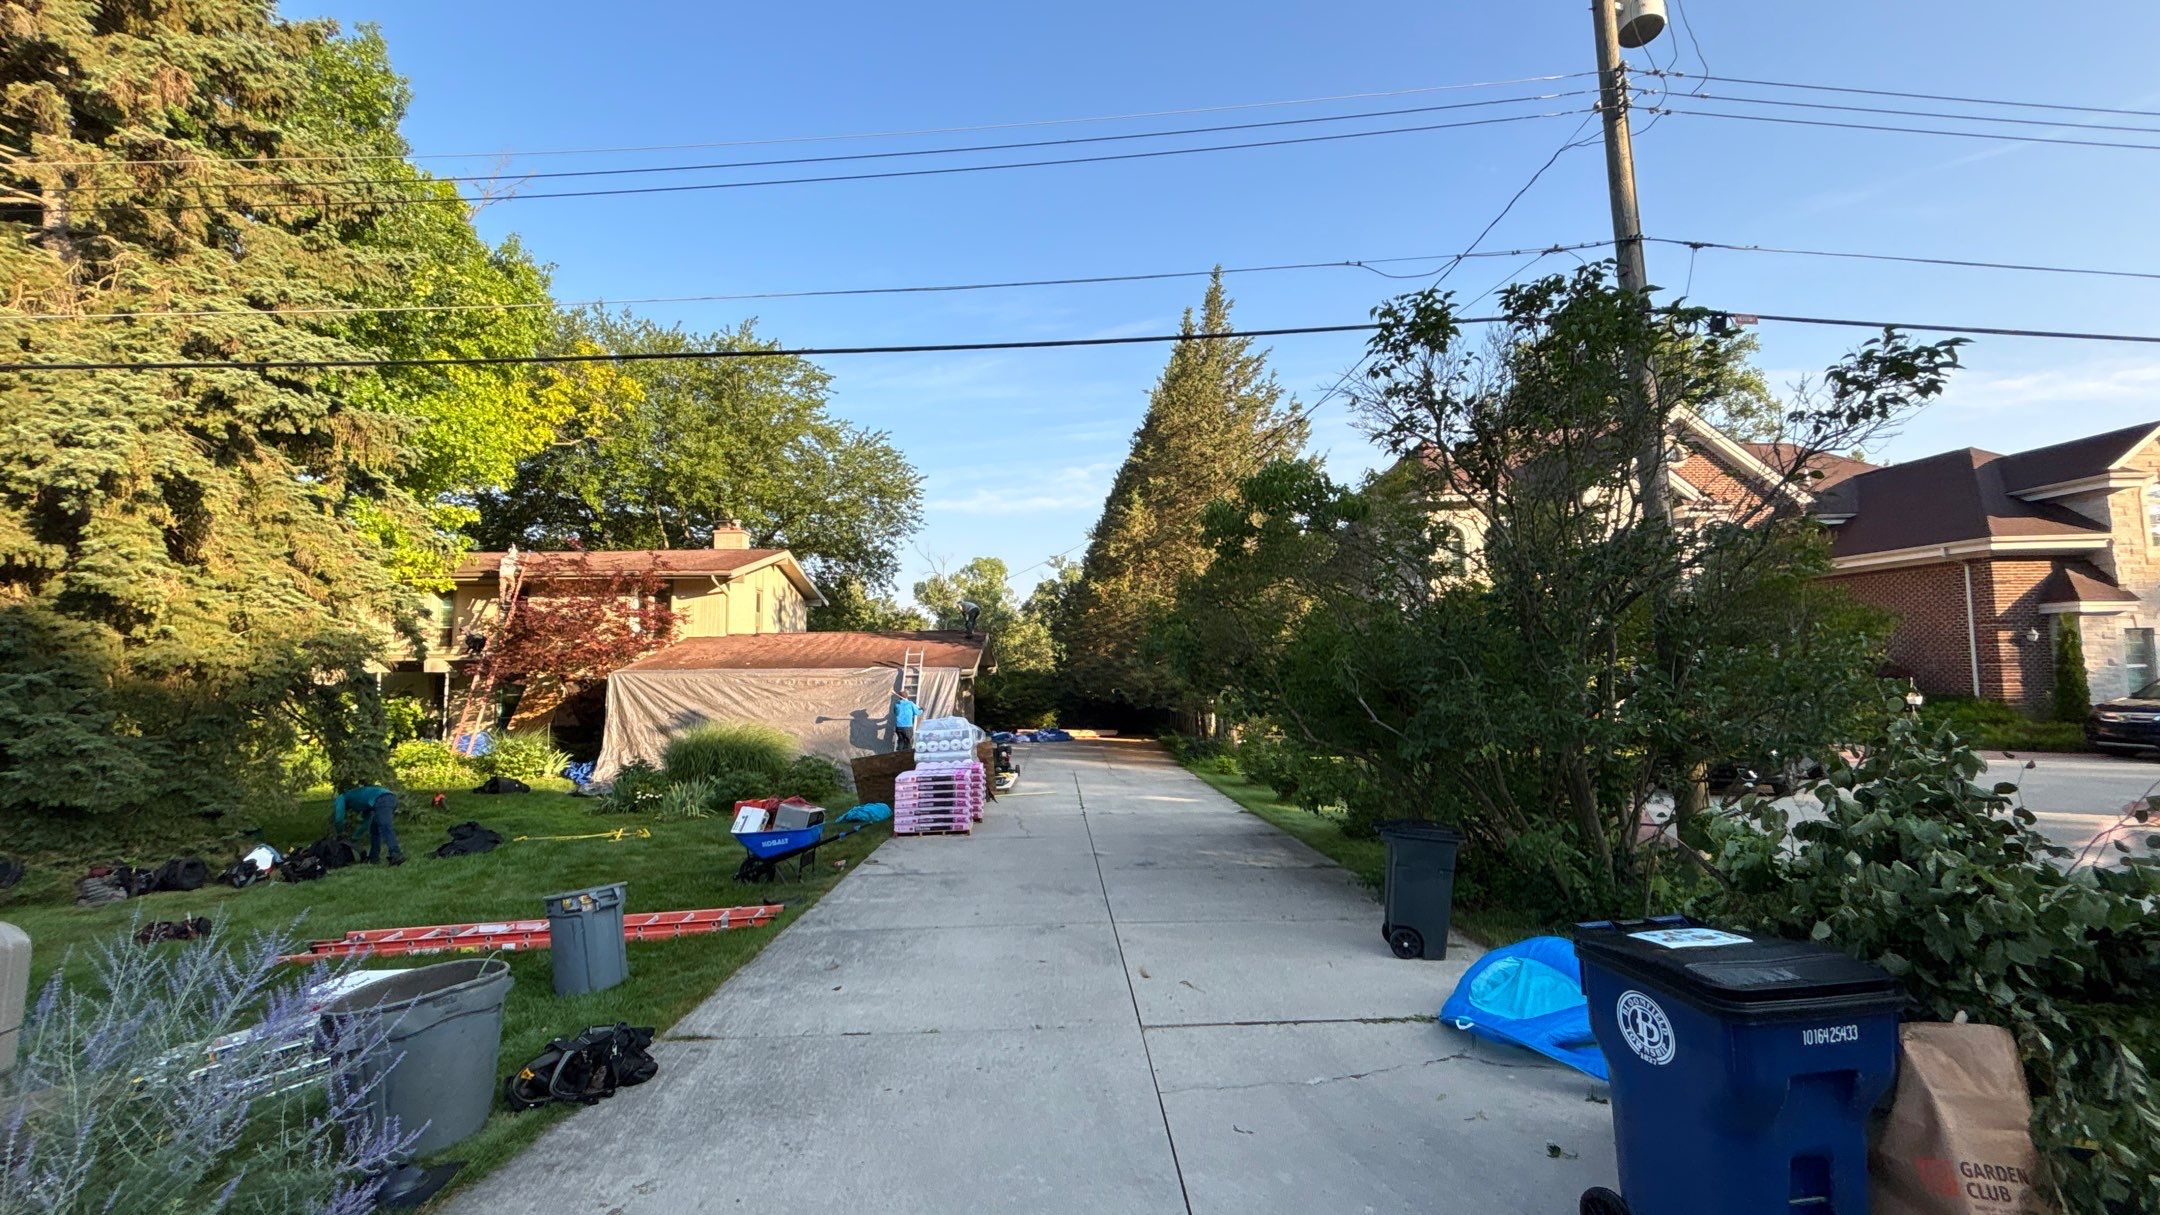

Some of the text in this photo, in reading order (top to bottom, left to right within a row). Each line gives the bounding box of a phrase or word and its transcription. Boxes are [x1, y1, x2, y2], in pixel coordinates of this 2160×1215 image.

[761, 838, 789, 848] KOBALT
[1622, 997, 1668, 1036] BLOOMFIELD
[1627, 1026, 1668, 1057] TOWNSHIP
[1802, 1025, 1859, 1046] 1016425433
[1960, 1161, 2030, 1185] GARDEN
[1966, 1182, 2012, 1203] CLUB
